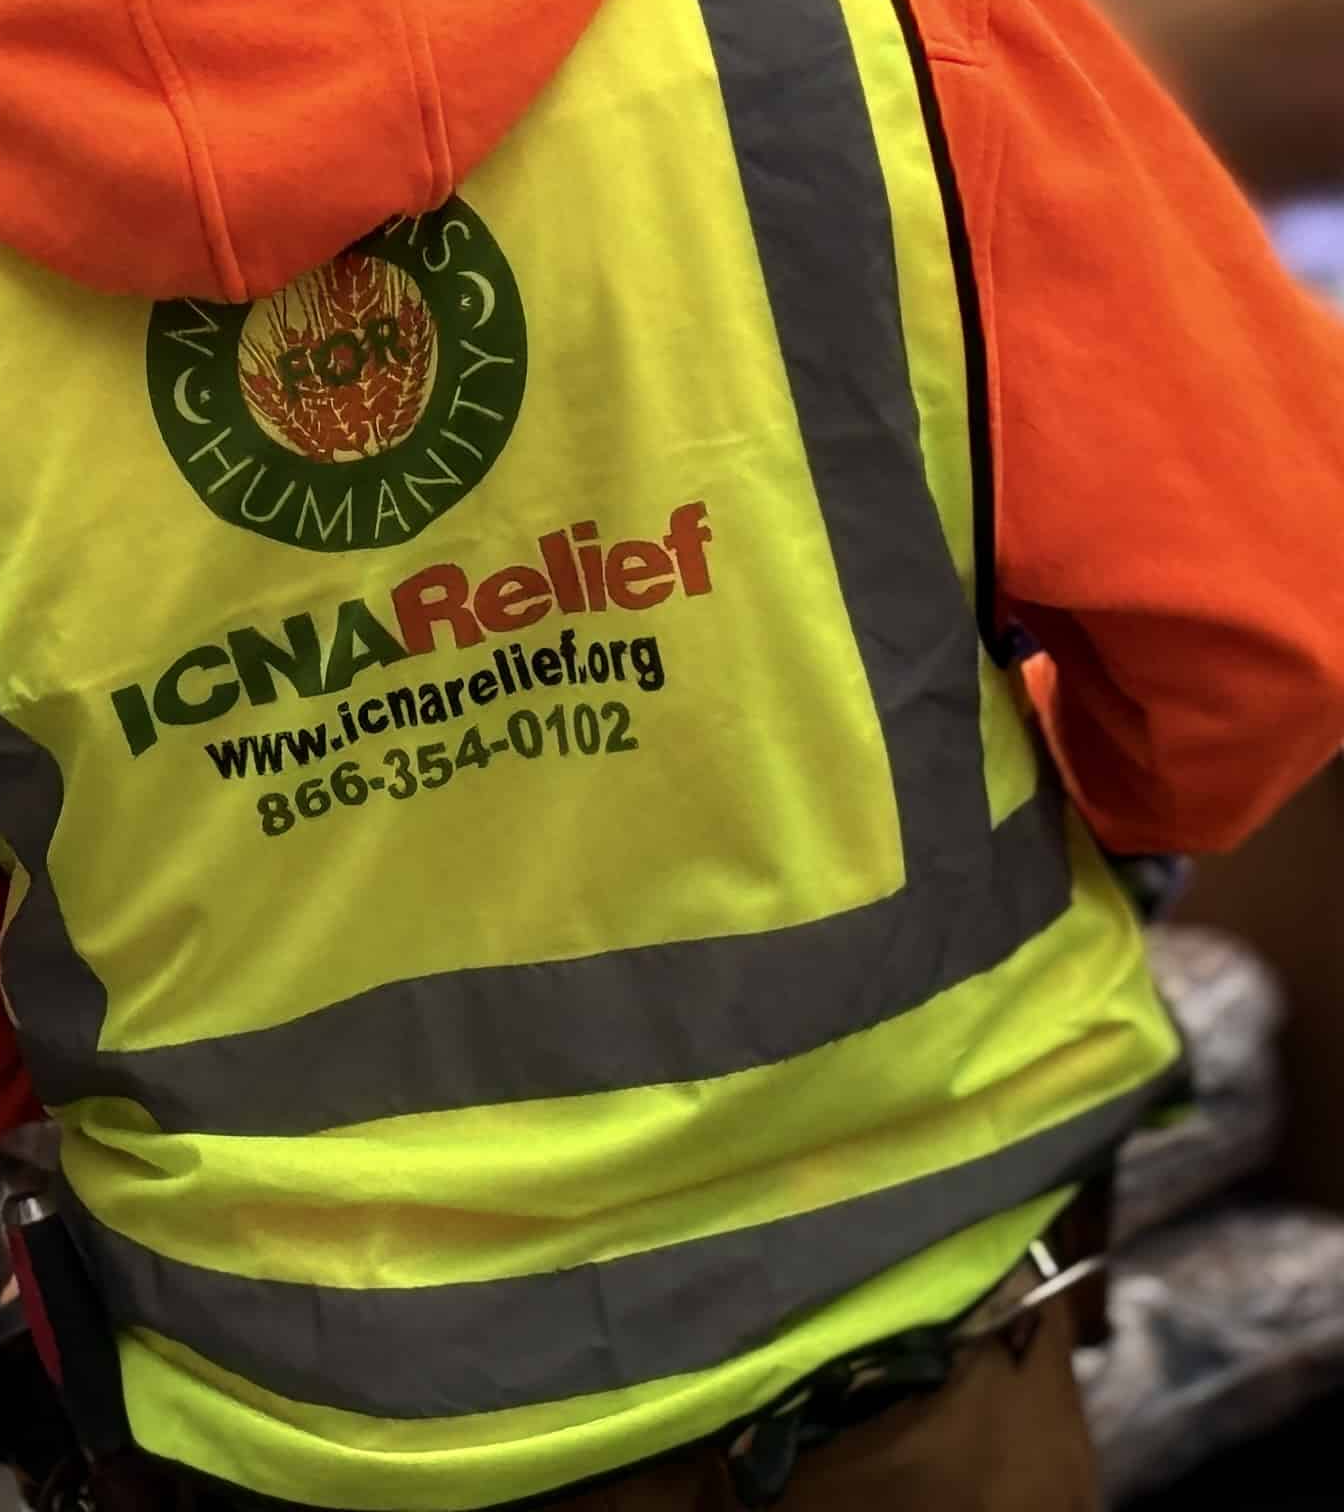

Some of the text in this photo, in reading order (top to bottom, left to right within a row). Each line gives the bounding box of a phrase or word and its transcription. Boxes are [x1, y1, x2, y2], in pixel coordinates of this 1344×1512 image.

[278, 314, 410, 401] FOR
[187, 339, 515, 544] HUMANITY
[205, 629, 666, 780] www.icnarelief.org
[256, 700, 639, 837] 866-354-0102
